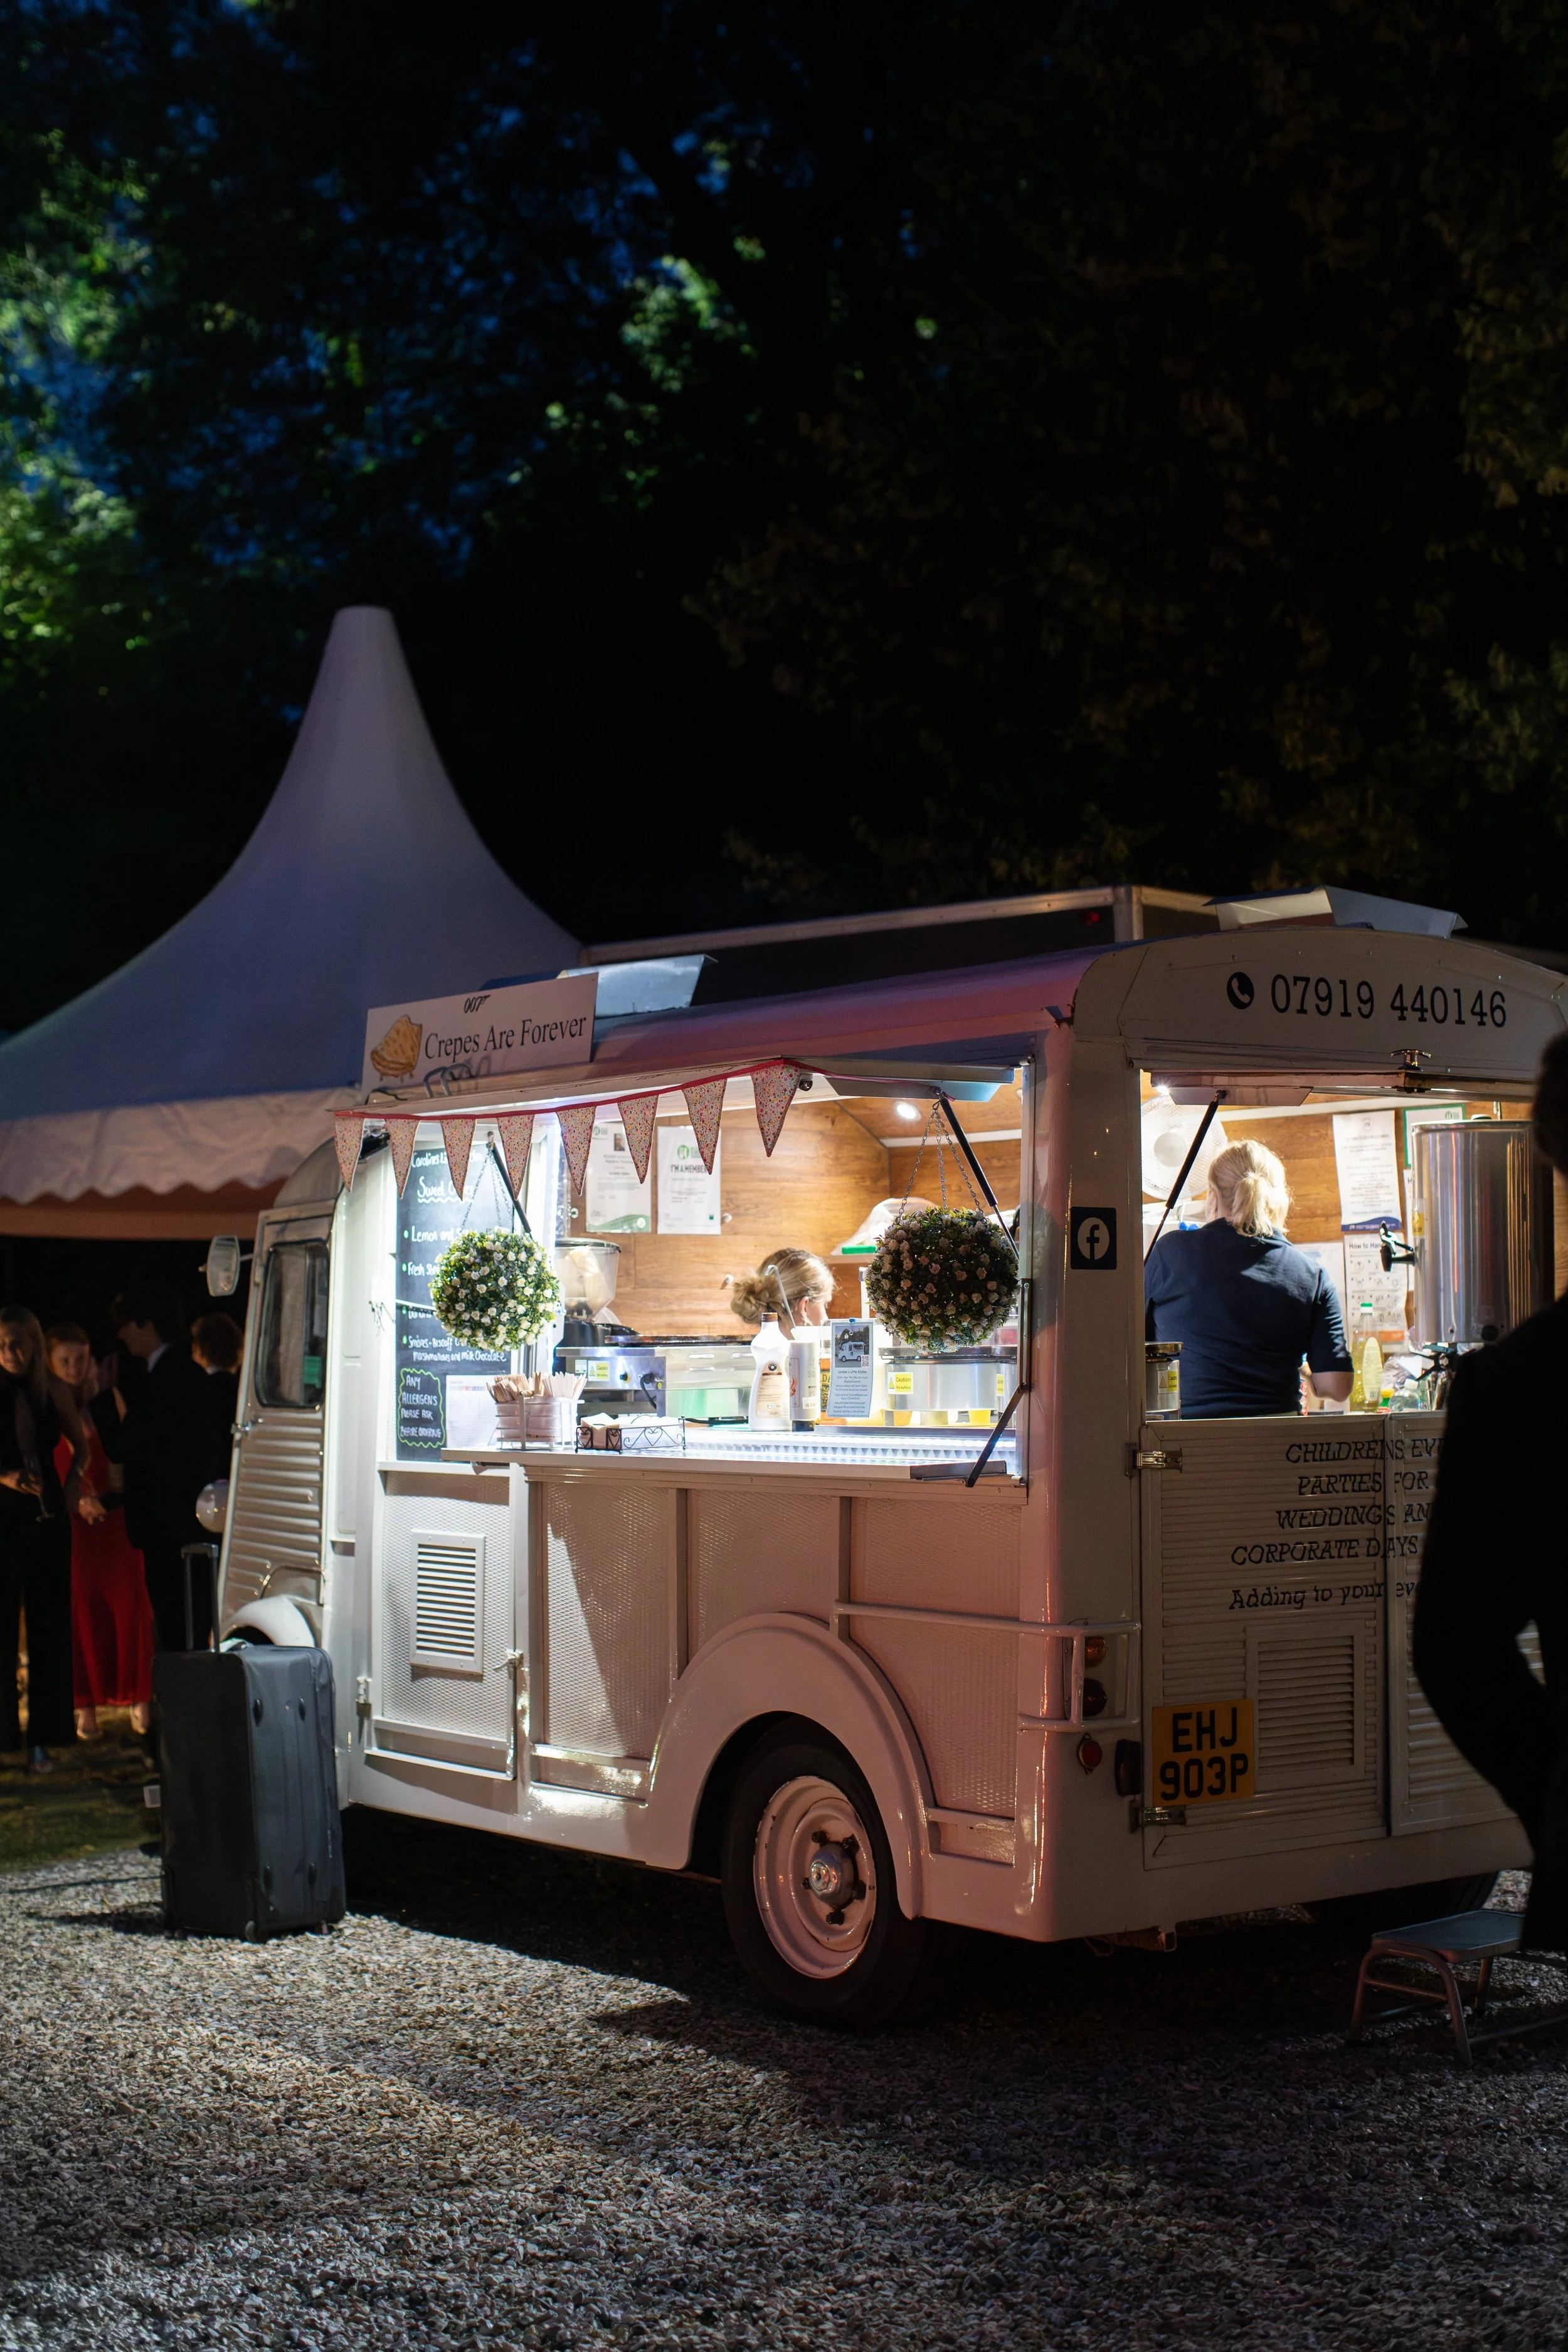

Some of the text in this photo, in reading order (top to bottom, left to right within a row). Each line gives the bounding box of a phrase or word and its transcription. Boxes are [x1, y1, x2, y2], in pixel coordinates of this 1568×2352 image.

[464, 994, 490, 1014] 007
[1271, 973, 1507, 1028] 07919 440146
[425, 1017, 588, 1062] Crepes Are Forever
[417, 1176, 445, 1197] Sweet
[411, 1225, 437, 1242] Lemon
[440, 1227, 455, 1242] and
[407, 1261, 425, 1276] Fresh
[406, 1374, 421, 1391] ANY
[401, 1391, 438, 1406] ALLERGENS
[401, 1407, 434, 1421] PLEASE ASK
[1286, 1438, 1405, 1463] CHILDRENS
[1298, 1471, 1429, 1496] PARTIES FOR
[1276, 1503, 1431, 1530] WEDDINGS AN
[1231, 1535, 1418, 1565] CORPORATE DAYS
[1229, 1586, 1307, 1610] Adding
[1313, 1585, 1333, 1602] to
[1340, 1582, 1385, 1606] your
[1172, 1707, 1237, 1753] EHJ
[1159, 1753, 1249, 1801] 903P
